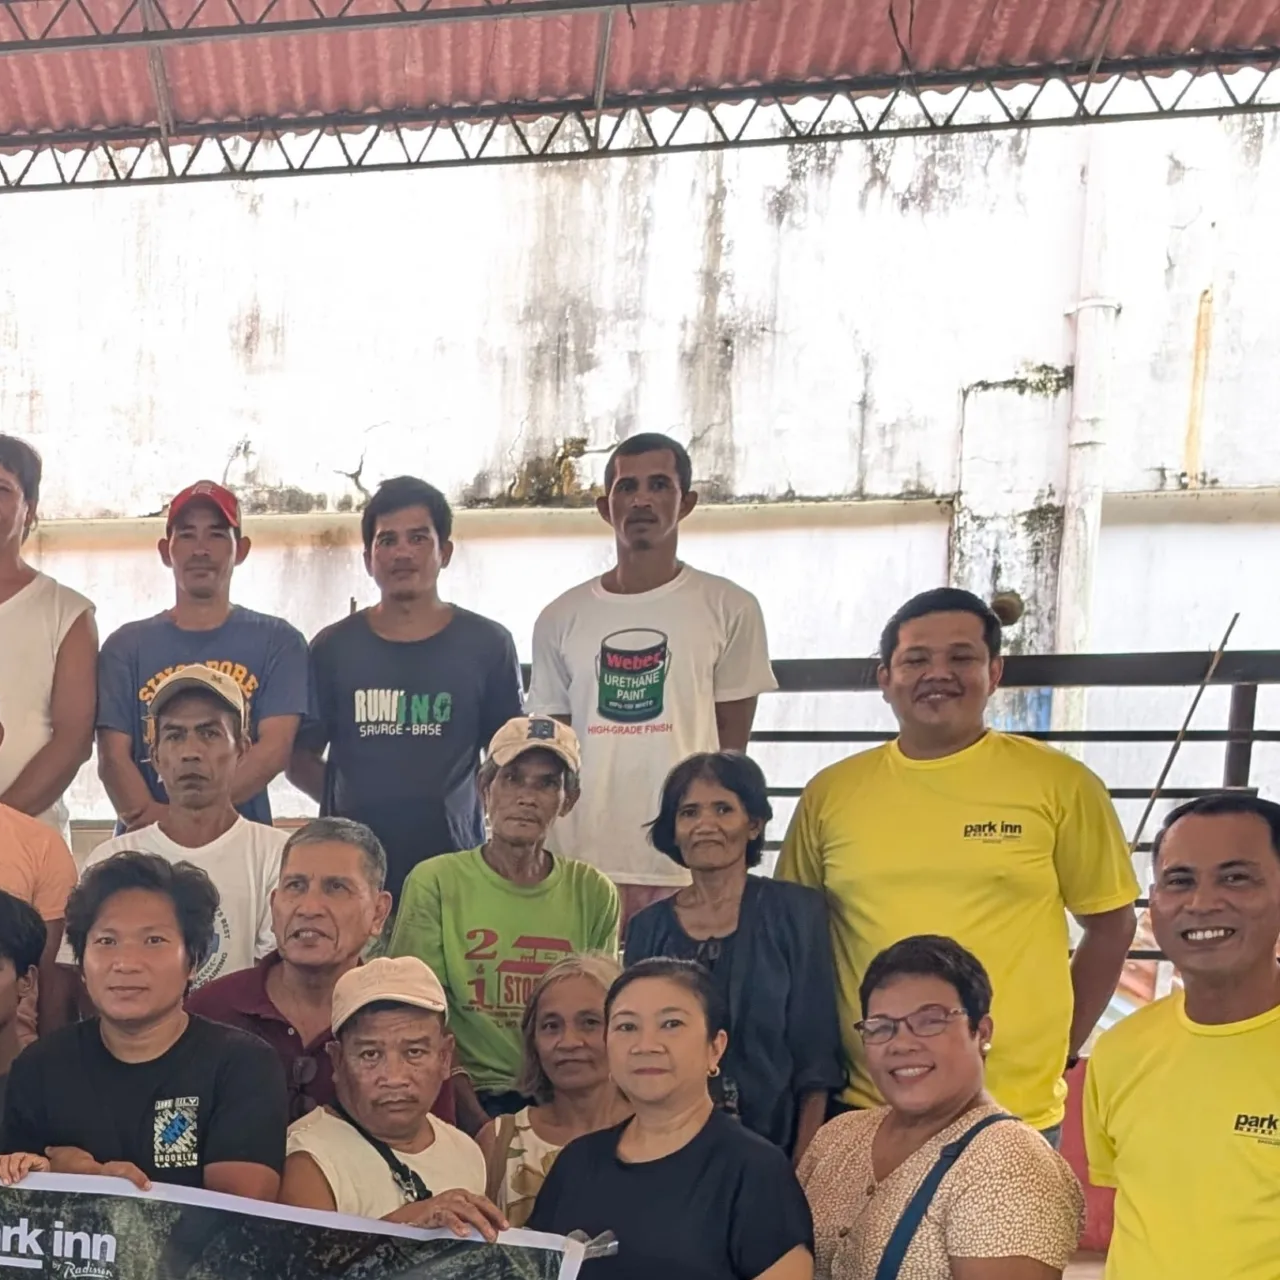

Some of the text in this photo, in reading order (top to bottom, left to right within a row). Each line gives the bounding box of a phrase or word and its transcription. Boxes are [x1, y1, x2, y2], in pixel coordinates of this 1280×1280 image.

[607, 651, 662, 670] Weber
[604, 672, 660, 687] URETHANE
[616, 688, 647, 701] PAINT
[587, 723, 673, 735] HIGH-GRADE FINISH
[963, 820, 1022, 838] park inn
[464, 928, 499, 960] 2
[467, 978, 495, 1009] 1
[503, 974, 541, 1005] STO
[1234, 1114, 1279, 1131] park
[153, 1152, 199, 1163] BROOKLYN
[52, 1221, 117, 1263] inn
